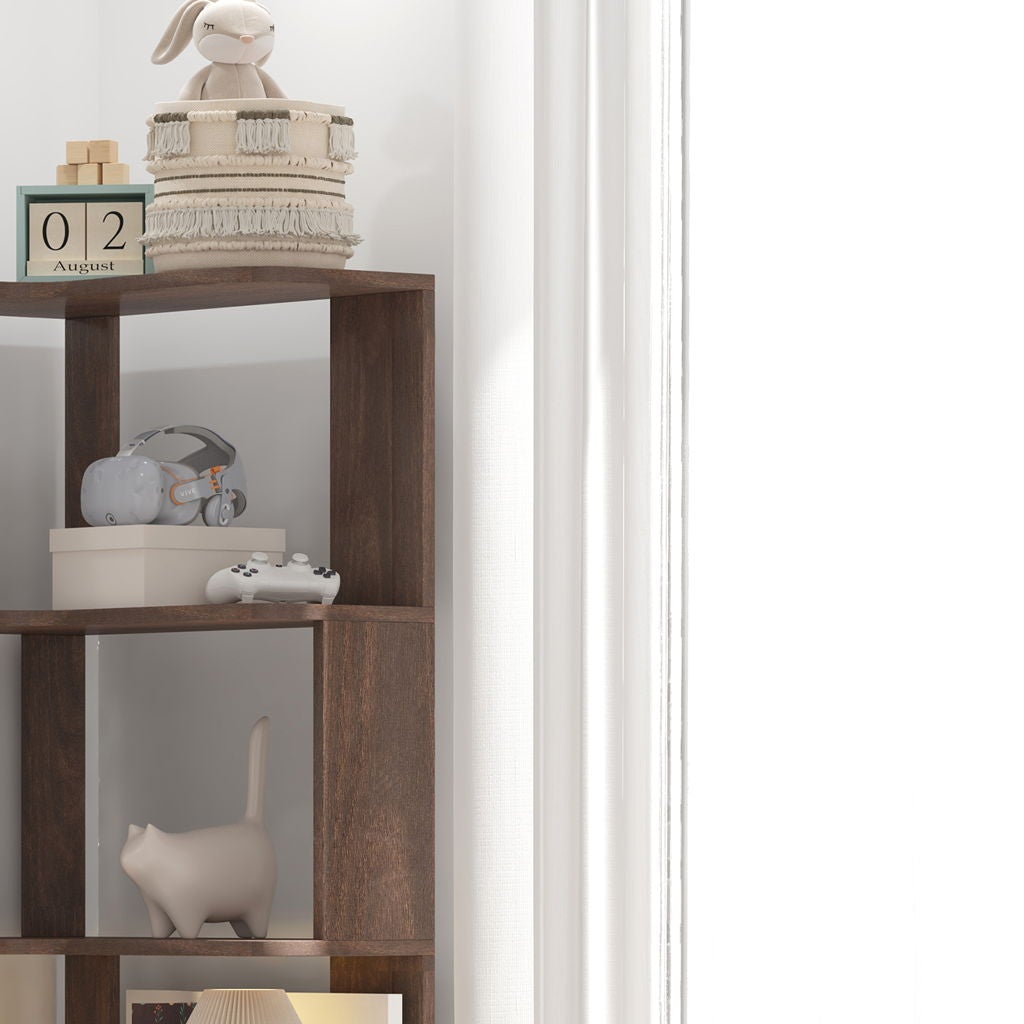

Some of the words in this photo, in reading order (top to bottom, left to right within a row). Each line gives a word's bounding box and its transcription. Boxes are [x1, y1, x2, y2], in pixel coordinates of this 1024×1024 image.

[42, 212, 69, 251] 0
[103, 211, 126, 250] 2
[54, 260, 115, 274] August
